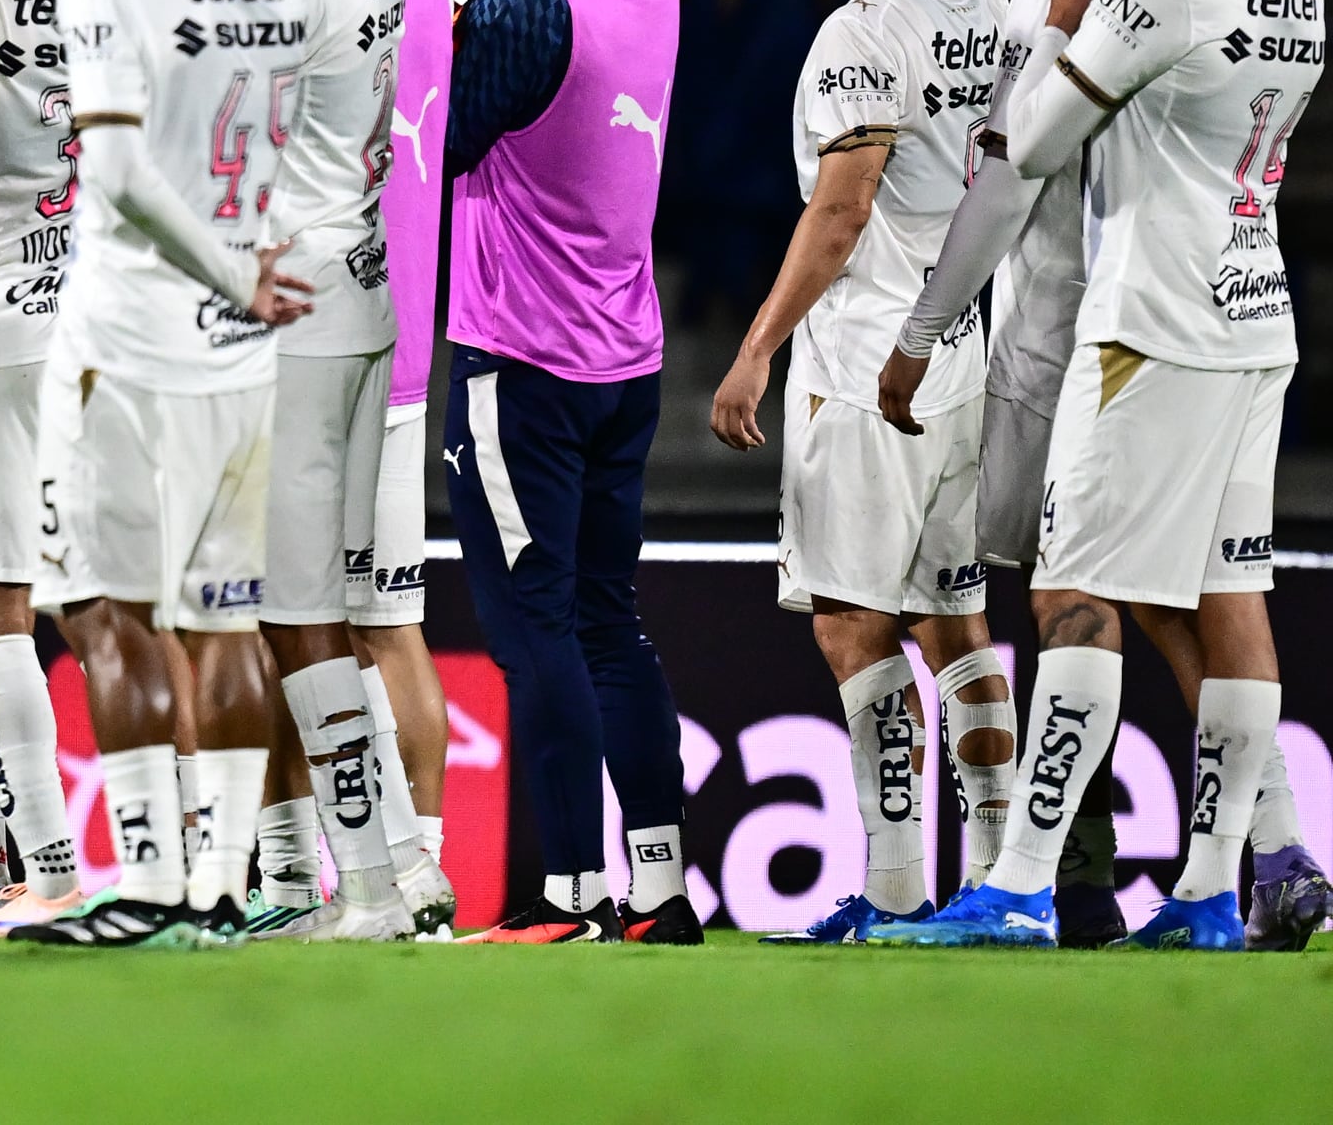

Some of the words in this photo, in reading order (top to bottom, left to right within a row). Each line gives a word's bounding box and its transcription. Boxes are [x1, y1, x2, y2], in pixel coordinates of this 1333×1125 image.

[35, 83, 82, 221] 3
[1028, 694, 1091, 831] CREST
[639, 845, 670, 862] CS
